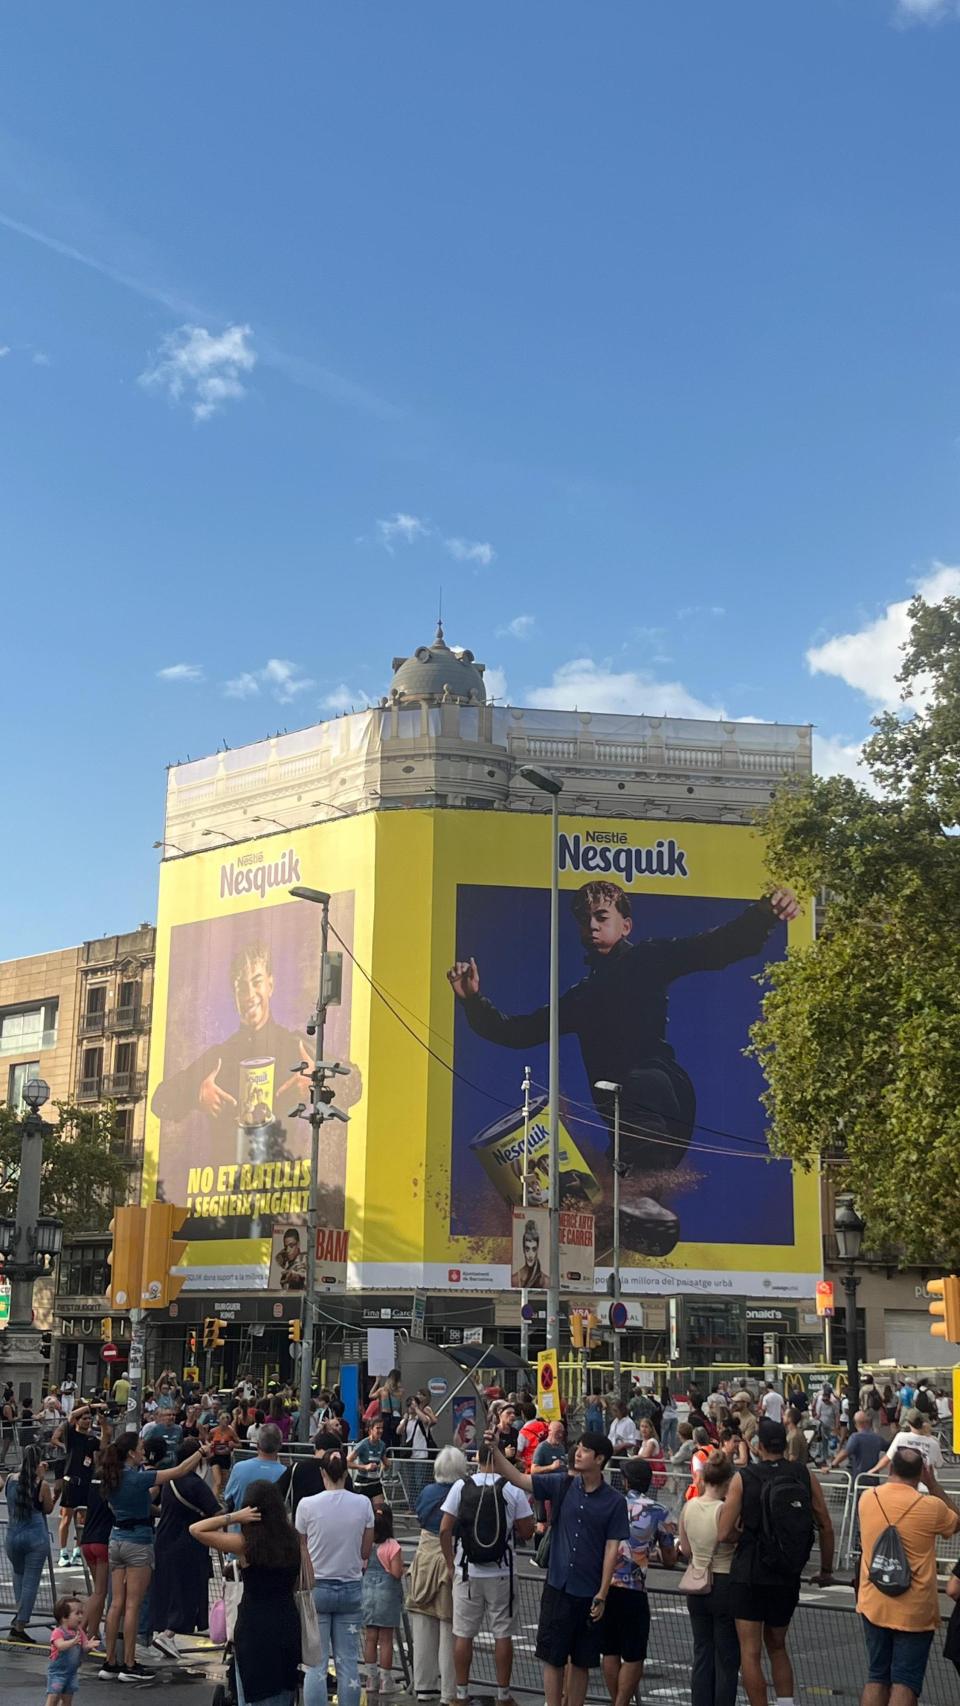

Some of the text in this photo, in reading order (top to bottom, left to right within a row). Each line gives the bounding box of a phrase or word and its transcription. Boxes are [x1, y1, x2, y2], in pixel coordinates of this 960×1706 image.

[220, 849, 300, 898] Nesquik
[558, 834, 688, 883] Nesquik
[493, 1123, 550, 1167] Nesquik
[187, 1159, 311, 1194] NO ET RATLLIS
[193, 1193, 253, 1217] SEGUEIX
[252, 1190, 310, 1220] JUGANT
[315, 1228, 350, 1263] BAM
[567, 1229, 593, 1247] CARRER
[631, 1278, 660, 1286] millora
[676, 1279, 712, 1289] paisatge
[713, 1280, 733, 1288] urbà
[62, 1319, 124, 1337] NUI
[220, 1311, 235, 1319] KING
